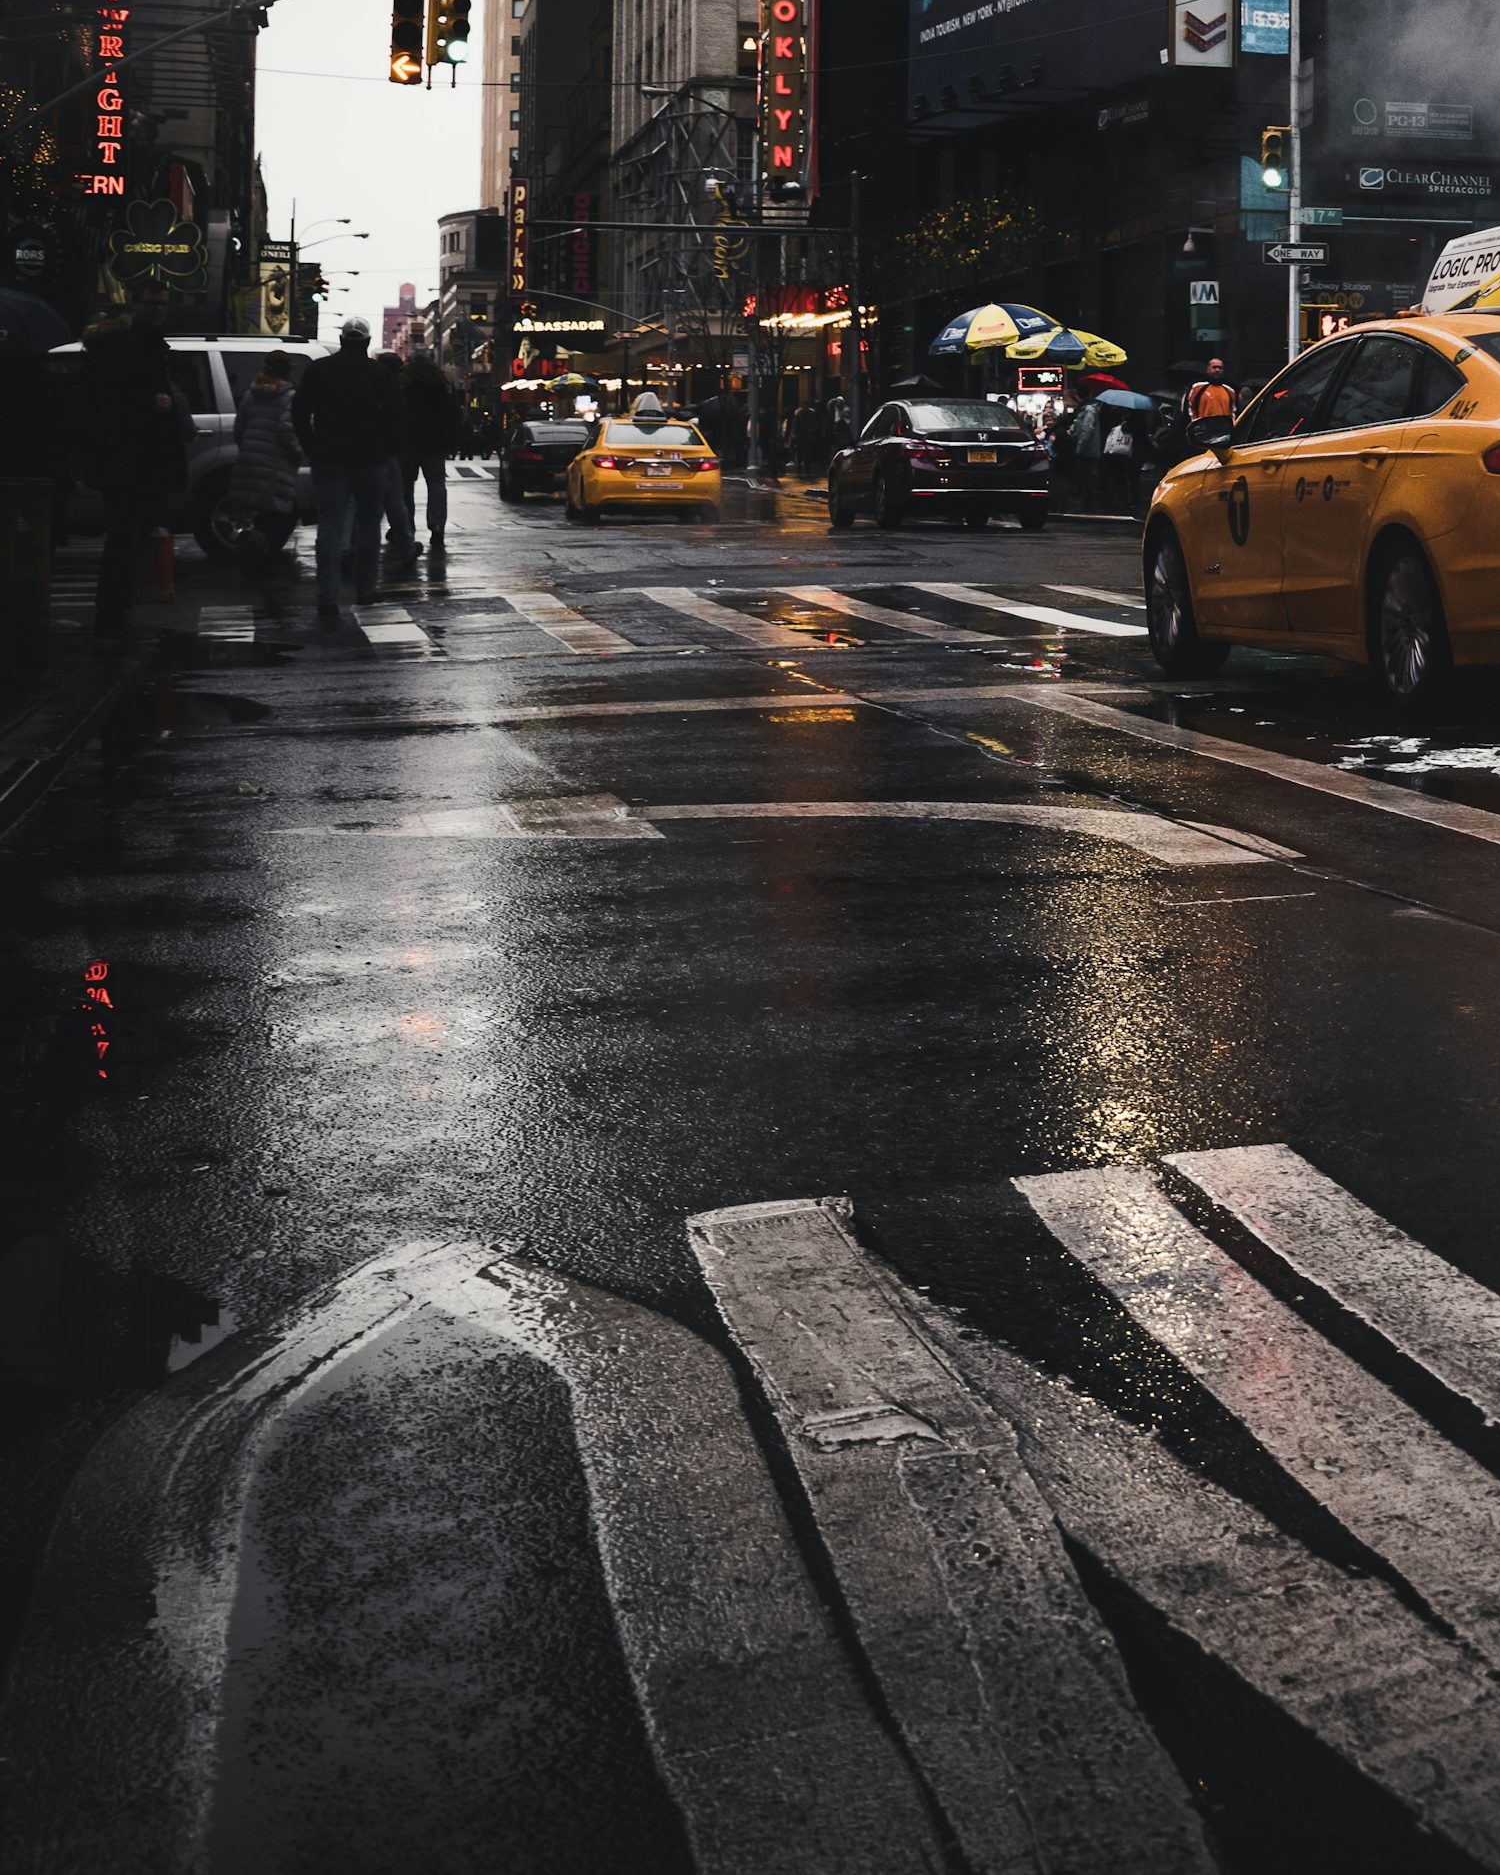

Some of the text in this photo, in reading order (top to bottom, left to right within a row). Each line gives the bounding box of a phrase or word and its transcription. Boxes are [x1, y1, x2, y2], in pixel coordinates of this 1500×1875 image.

[920, 27, 936, 43] INDIA
[962, 12, 976, 26] NEW
[977, 4, 994, 21] YORK
[1388, 115, 1426, 127] PG-13
[1428, 185, 1492, 196] SPECTACOLOR
[1319, 211, 1325, 222] 7
[514, 185, 527, 268] park
[1273, 249, 1320, 258] ONE WAY
[1432, 255, 1474, 281] LOGIC
[1309, 282, 1372, 292] Subway Station
